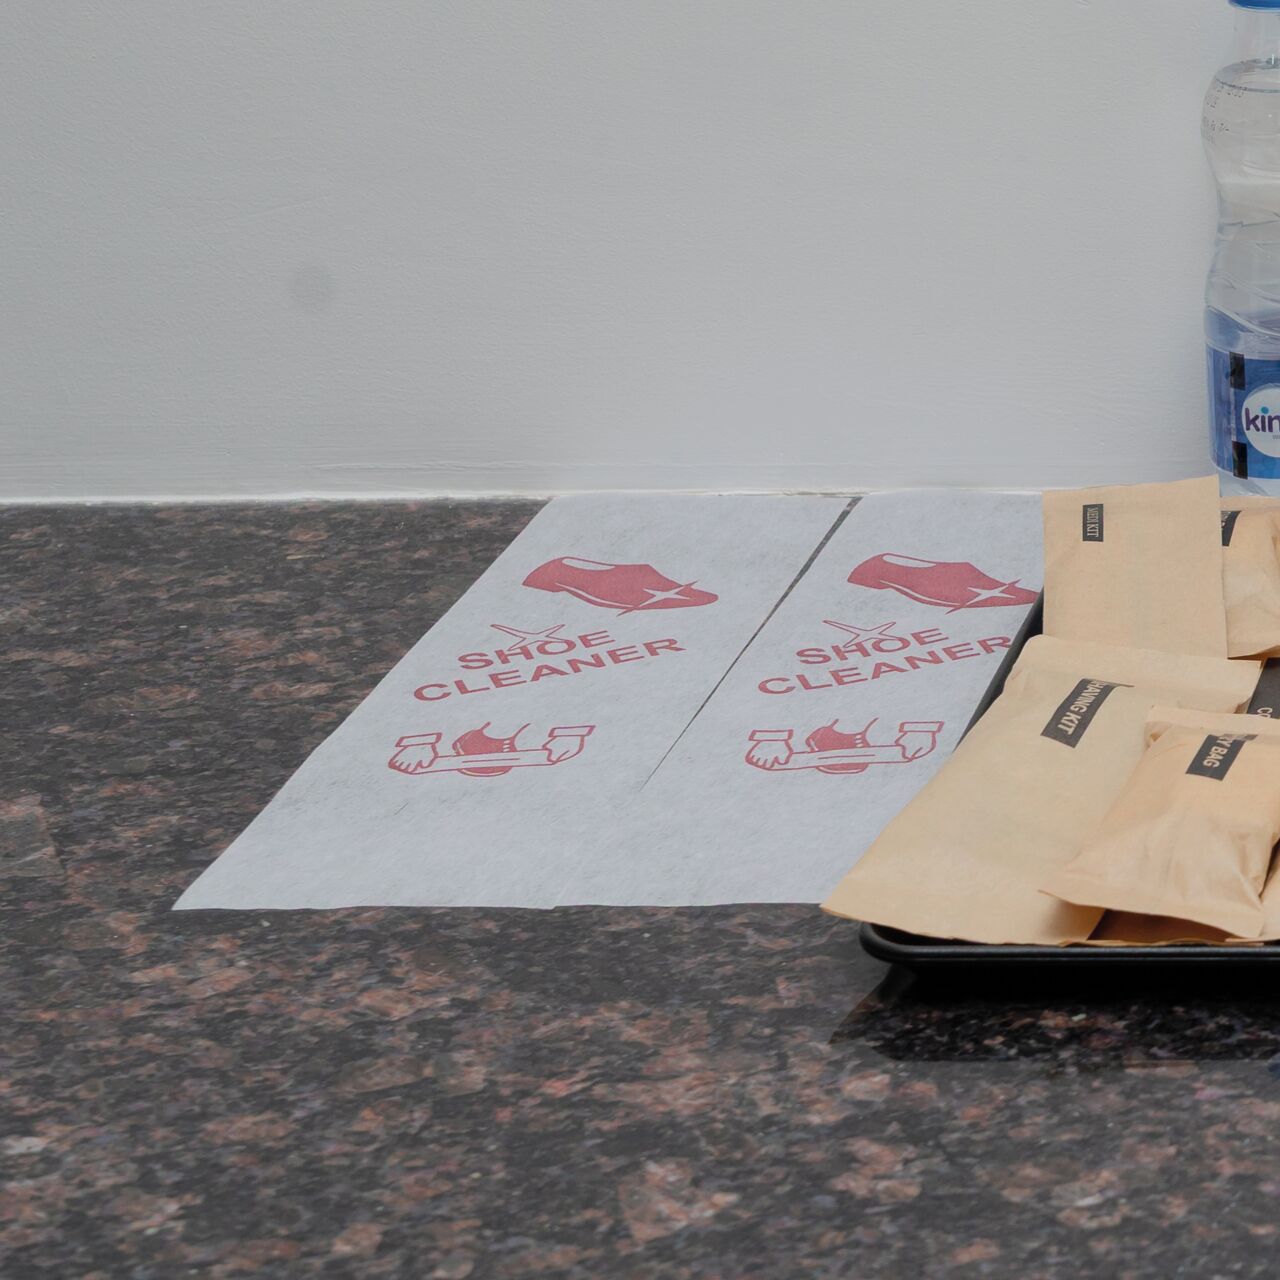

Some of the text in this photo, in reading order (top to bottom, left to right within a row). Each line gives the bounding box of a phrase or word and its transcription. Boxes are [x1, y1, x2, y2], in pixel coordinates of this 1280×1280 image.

[1086, 507, 1099, 538] MEDI KIT
[457, 629, 617, 670] SHOE
[757, 636, 1012, 695] CLEANER
[796, 628, 949, 664] SHOE
[413, 638, 687, 701] CLEANER
[1057, 679, 1105, 736] HAVING KIT
[1202, 745, 1229, 768] BAG
